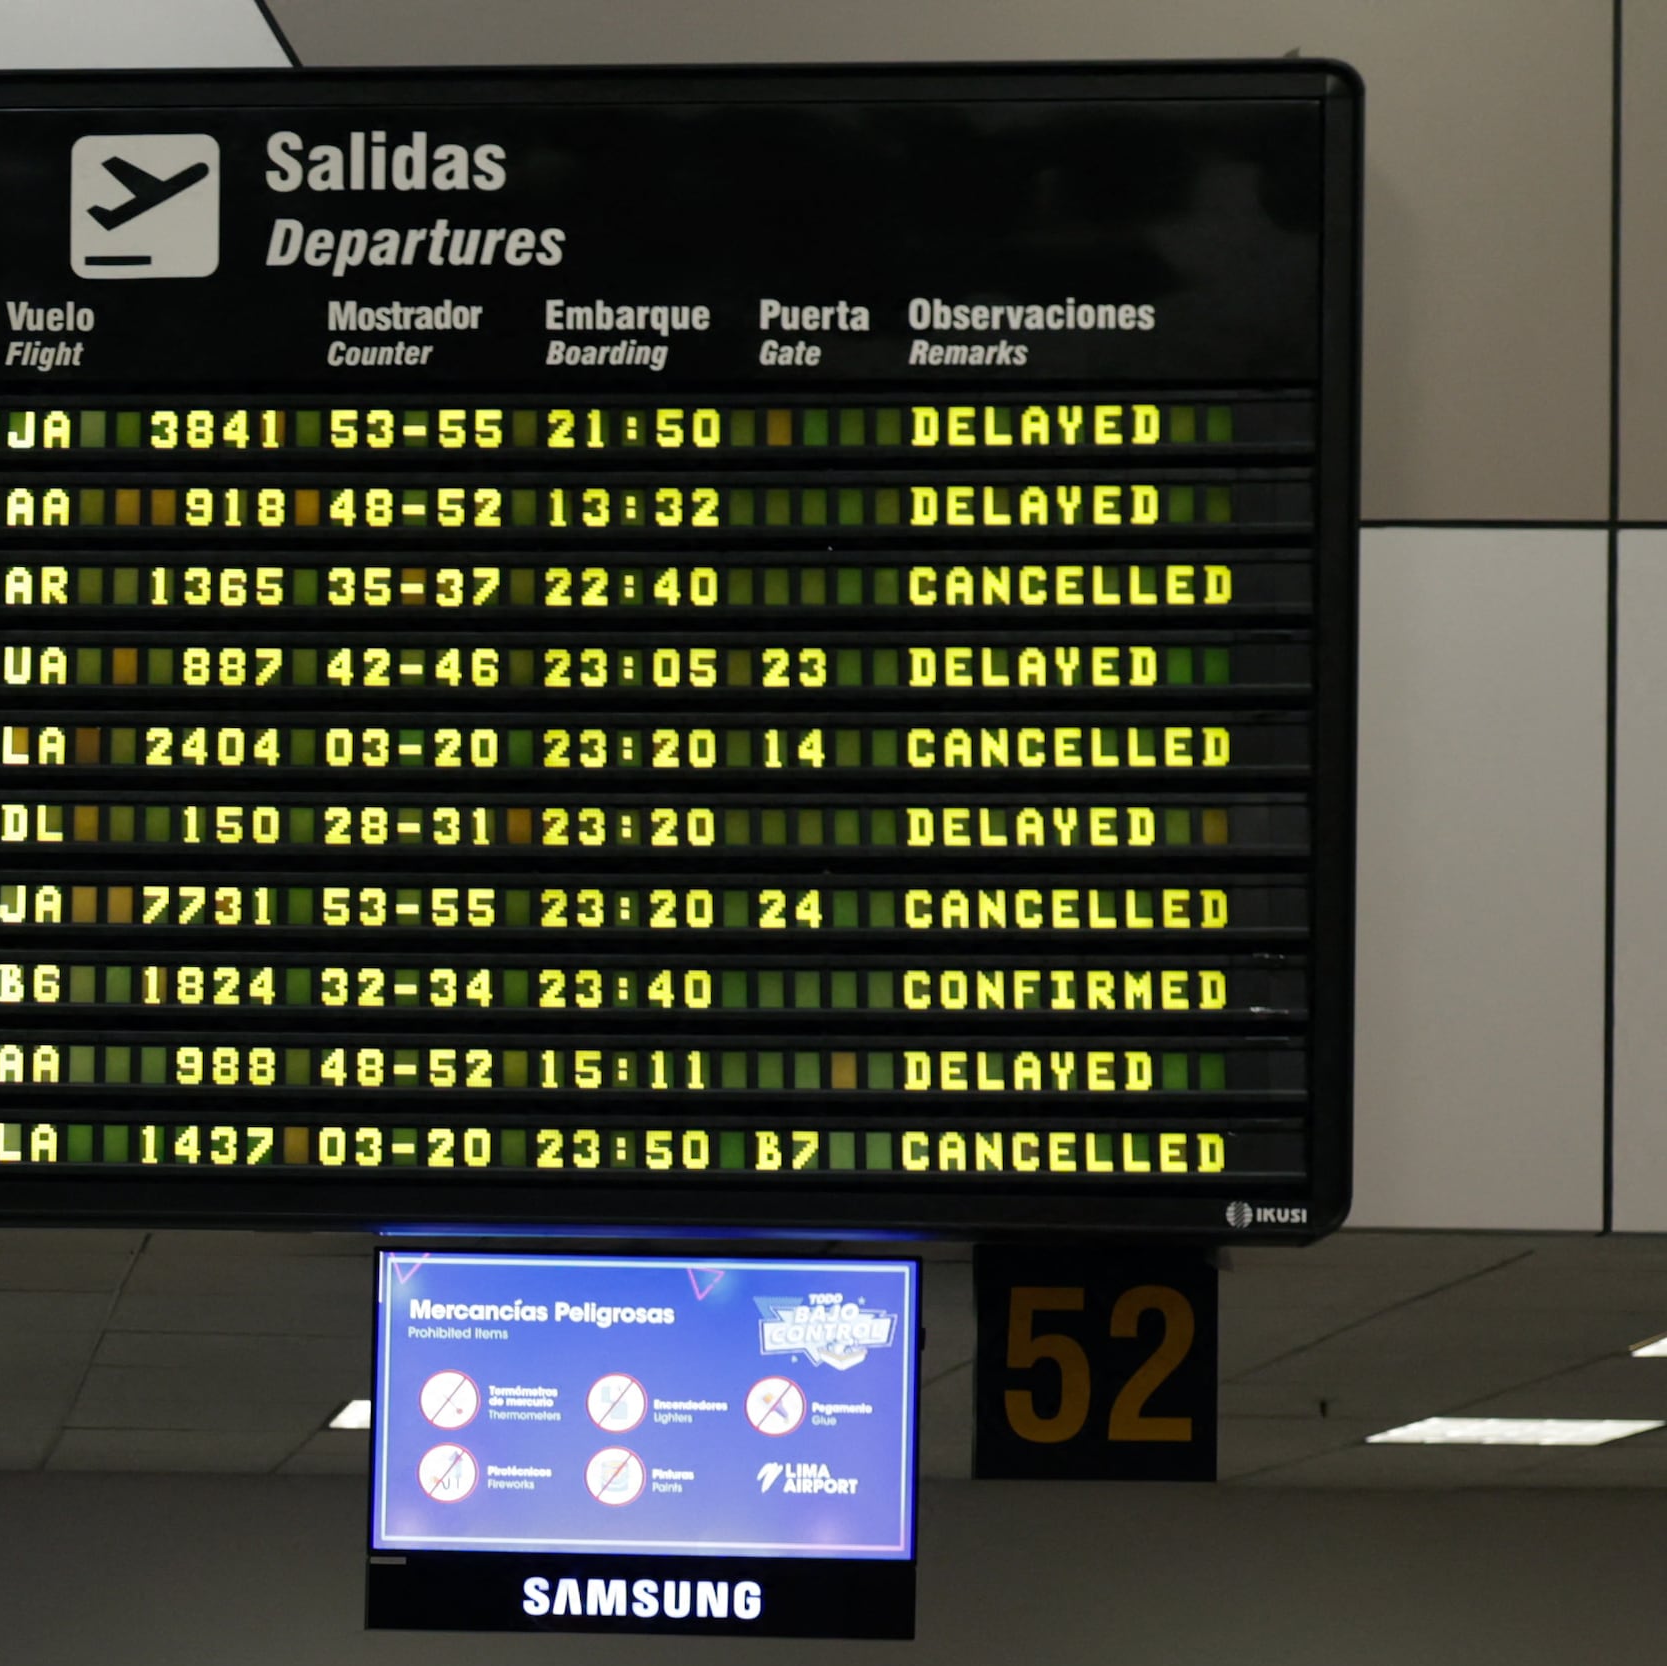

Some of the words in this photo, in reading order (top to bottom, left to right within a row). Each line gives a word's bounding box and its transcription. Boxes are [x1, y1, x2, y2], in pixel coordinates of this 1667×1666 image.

[266, 131, 505, 192] Salidas
[266, 219, 565, 276] Departures
[7, 301, 94, 331] Vuelo
[329, 300, 482, 331] Mostrador
[546, 300, 709, 336] Embarque
[760, 299, 869, 330] Puerta
[909, 297, 1155, 330] Observaciones
[6, 341, 83, 371] Flight
[328, 341, 433, 366] Counter
[546, 340, 668, 371] Boarding
[760, 340, 821, 365] Gate
[909, 340, 1028, 365] Remarks
[8, 411, 69, 448] JA
[152, 411, 278, 448] 3841
[332, 410, 501, 447] 53-55
[549, 410, 719, 447] 21:50
[913, 406, 1159, 445] DELAYED
[6, 567, 67, 604] AR
[152, 568, 282, 605] 1365
[329, 568, 499, 606] 35-37
[546, 569, 716, 605] 22:40
[910, 567, 1230, 604] CANCELLED
[3, 727, 64, 764] LA
[147, 728, 279, 765] 2404
[327, 729, 497, 766] 03-20
[545, 730, 715, 767] 23:20
[766, 730, 824, 767] 14
[909, 729, 1229, 766] CANCELLED
[145, 967, 275, 1004] 1824
[322, 969, 492, 1006] 32-34
[540, 970, 710, 1008] 23:40
[905, 972, 1225, 1009] CONFIRMED
[1255, 1205, 1307, 1224] IKUSI
[410, 1299, 549, 1321] Mercancías
[554, 1302, 675, 1328] Peligrosas
[795, 1303, 860, 1323] BAJO
[809, 1293, 843, 1305] TODO
[408, 1327, 471, 1339] Prohibited
[475, 1327, 509, 1340] Items
[771, 1321, 882, 1344] CONTROL
[1005, 1283, 1196, 1445] 52
[812, 1416, 837, 1426] Glue
[786, 1463, 830, 1478] LIMA
[784, 1479, 858, 1494] AIRPORT
[522, 1576, 763, 1621] SAMSUNG
